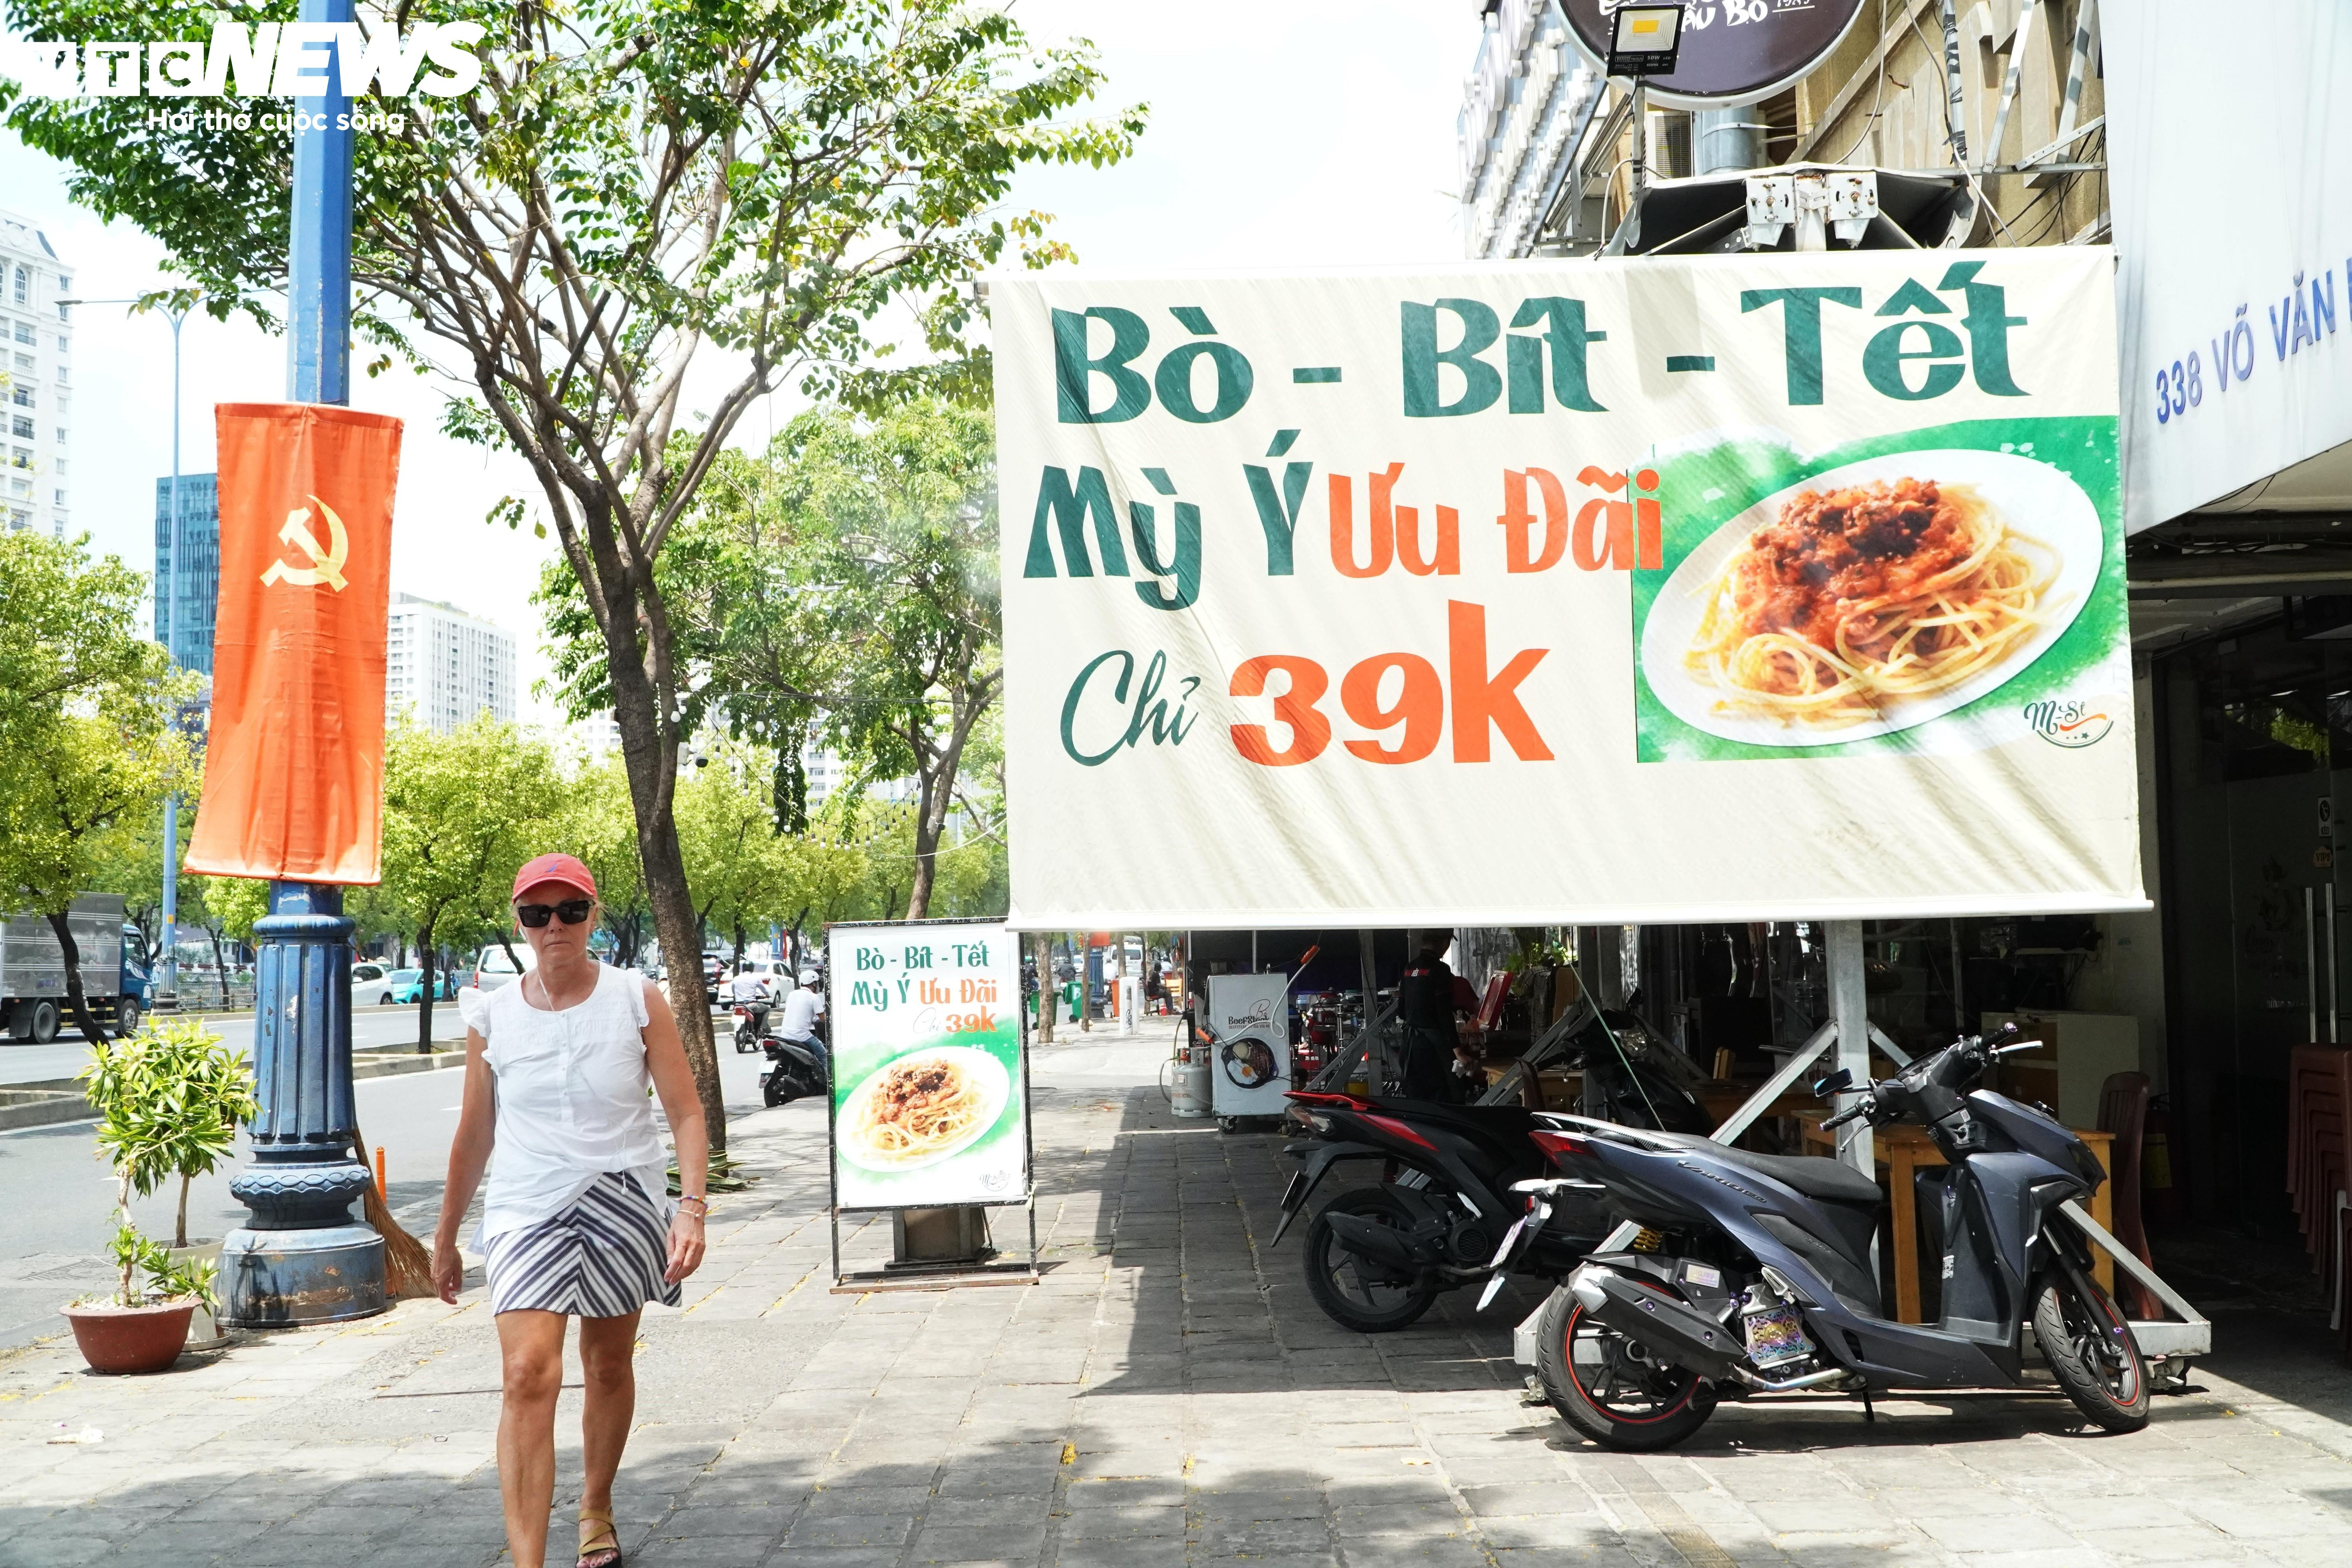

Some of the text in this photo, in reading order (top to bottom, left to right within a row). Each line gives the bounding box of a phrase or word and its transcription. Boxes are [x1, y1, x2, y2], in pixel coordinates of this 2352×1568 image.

[1051, 307, 1254, 424] Bò
[1401, 296, 1611, 418] Bít
[1741, 261, 2032, 406] Tết
[2156, 351, 2202, 424] 338
[2211, 303, 2254, 391] VÕ
[2269, 269, 2336, 361] VĂN
[1023, 429, 1663, 610] Mỳ Ý Ưu Đãi
[1060, 599, 1556, 767] Chỉ 39k
[851, 972, 996, 1012] Mỳ Ý Ưu Đãi
[857, 947, 884, 971] Bò
[905, 946, 933, 969] Bít
[951, 940, 990, 967] Tết
[946, 1005, 997, 1033] 39k
